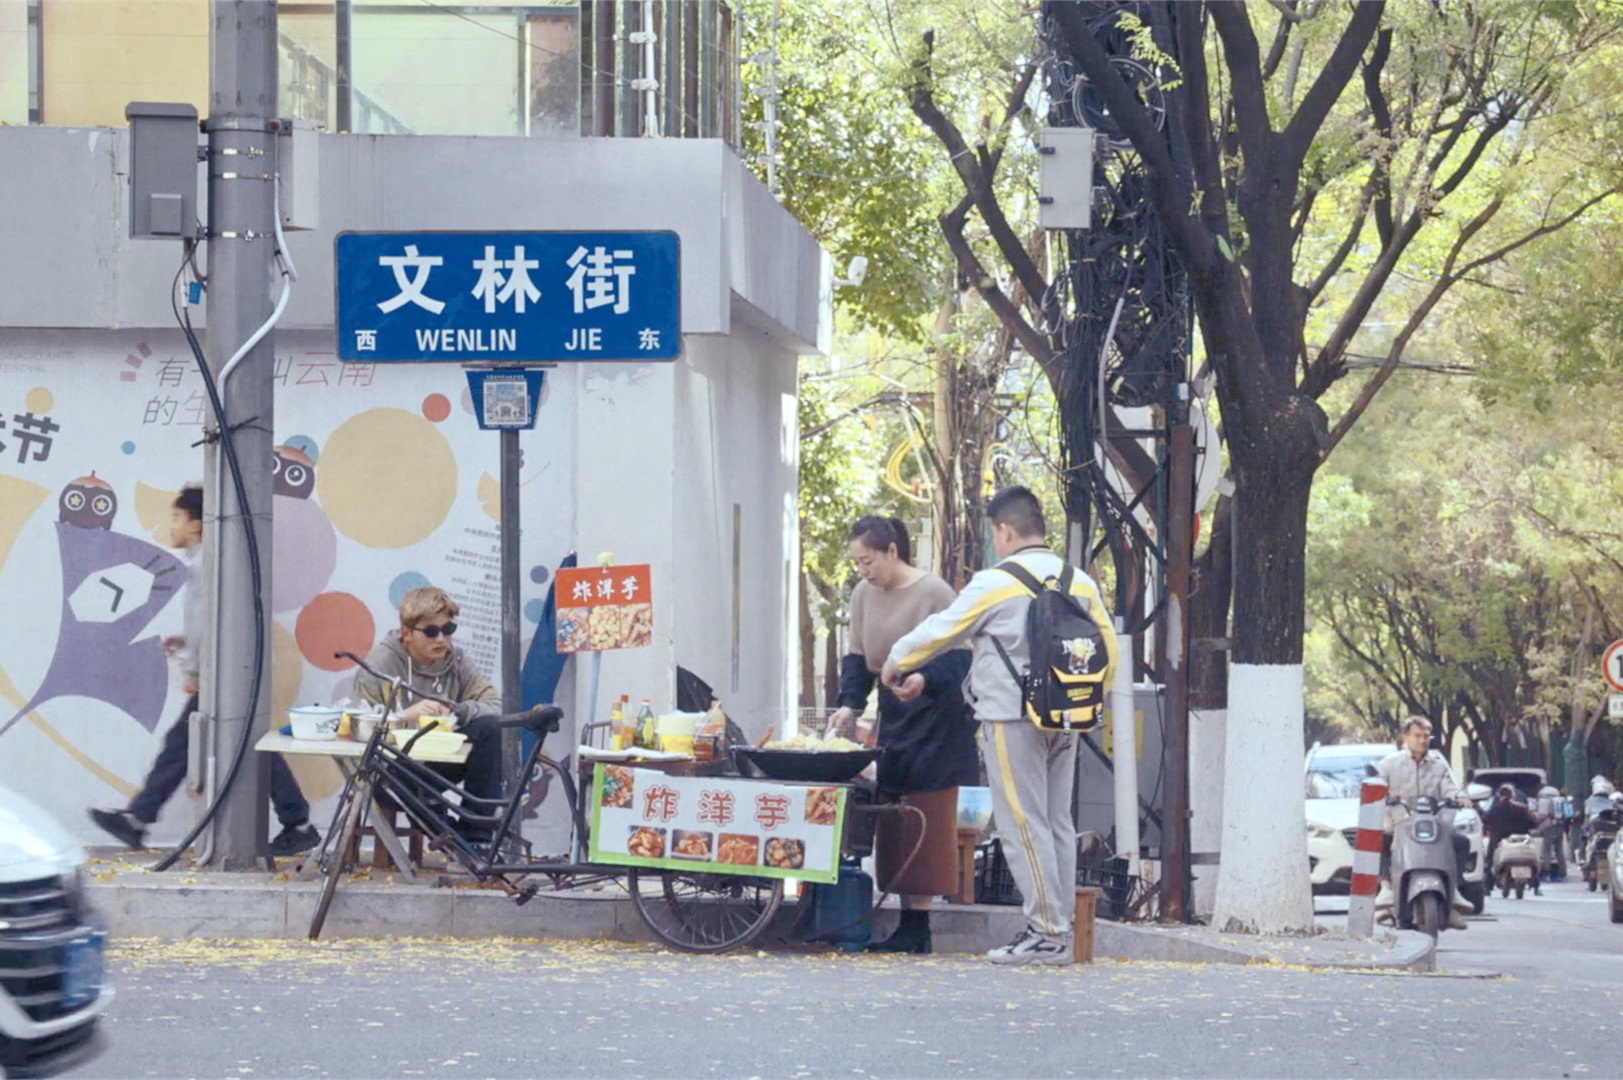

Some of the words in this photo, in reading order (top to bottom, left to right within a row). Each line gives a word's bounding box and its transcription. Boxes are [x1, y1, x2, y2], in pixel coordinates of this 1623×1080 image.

[377, 244, 636, 316] 文林街
[355, 329, 377, 351] 西
[415, 329, 517, 351] WENLIN
[565, 329, 602, 351] JIE
[638, 328, 661, 351] 东
[0, 411, 61, 464] 节
[572, 577, 639, 602] 炸洋芋
[642, 784, 792, 830] 炸洋芋
